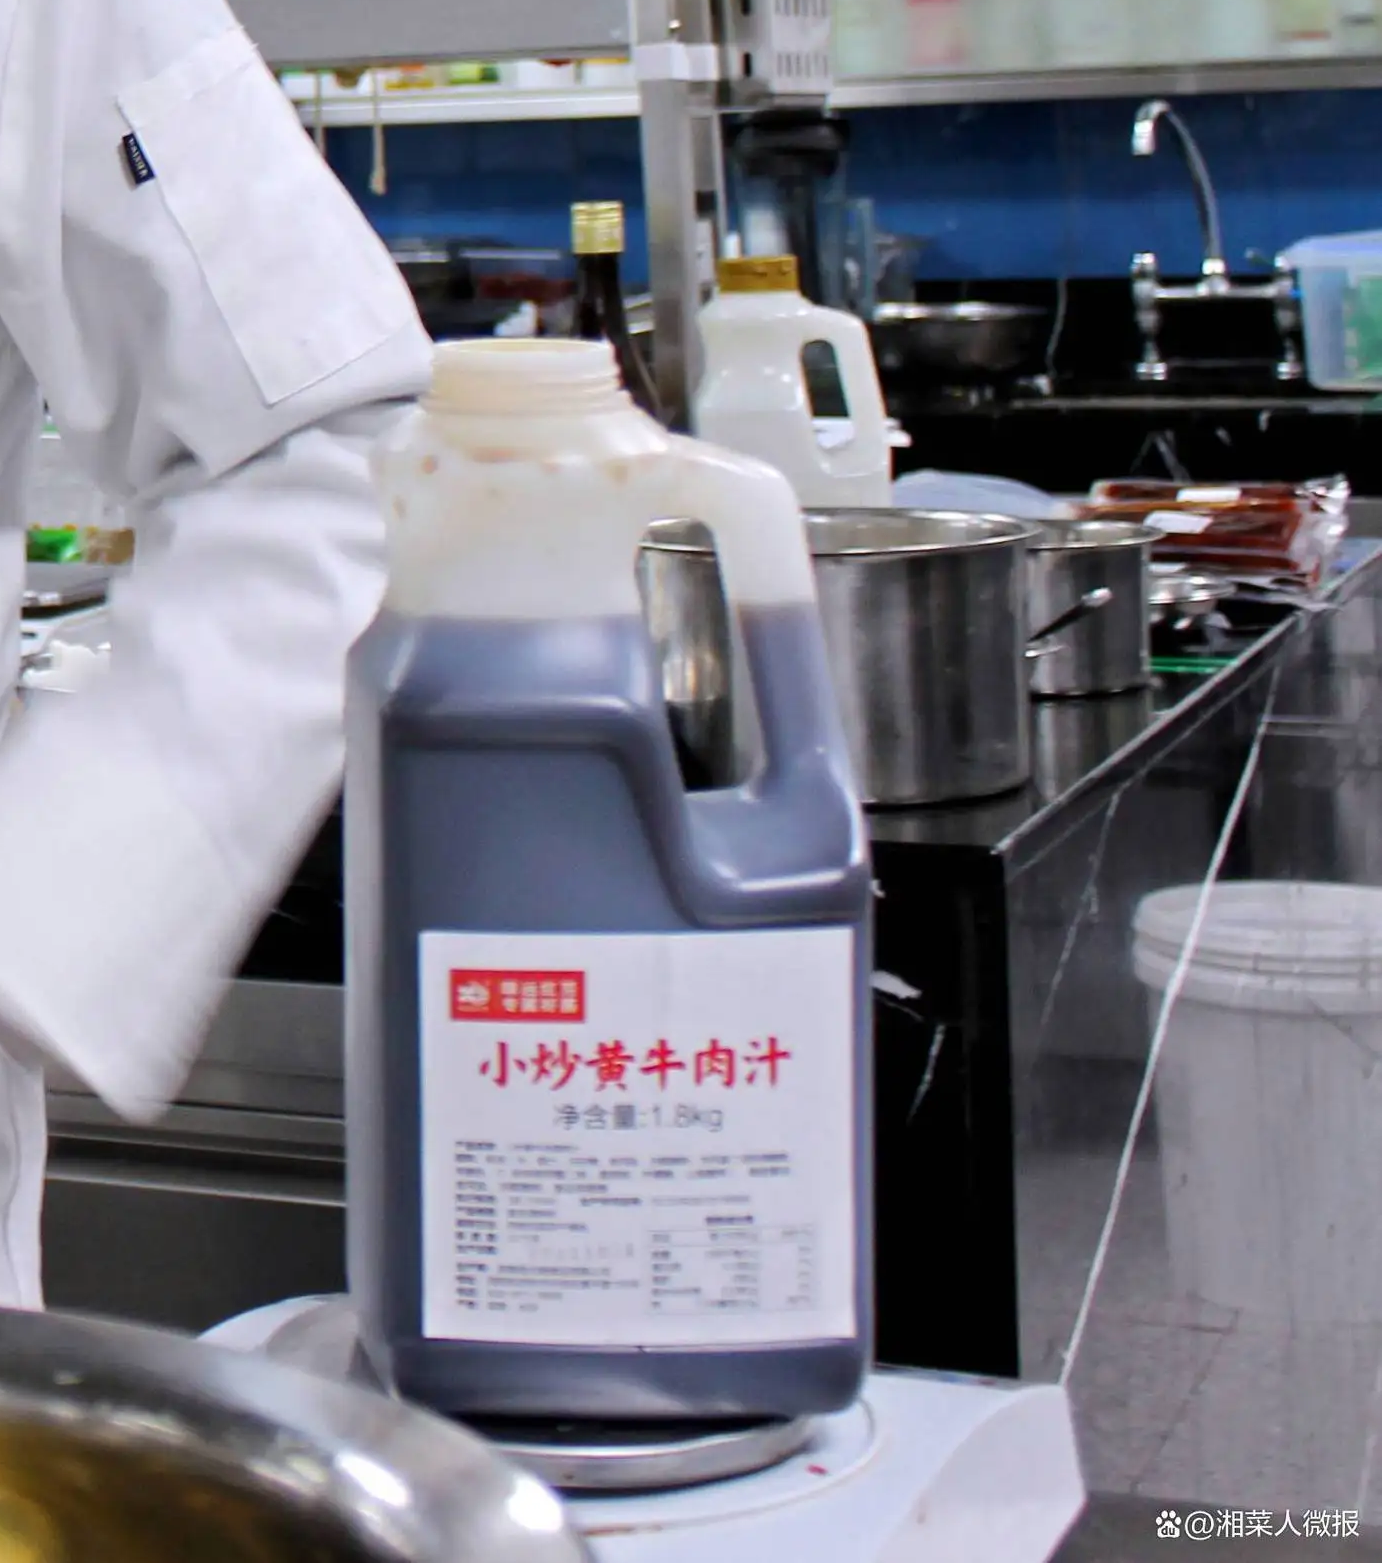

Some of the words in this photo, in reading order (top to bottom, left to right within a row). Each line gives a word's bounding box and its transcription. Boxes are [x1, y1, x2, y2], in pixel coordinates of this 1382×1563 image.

[479, 1036, 792, 1091] 小炒黄牛肉汁
